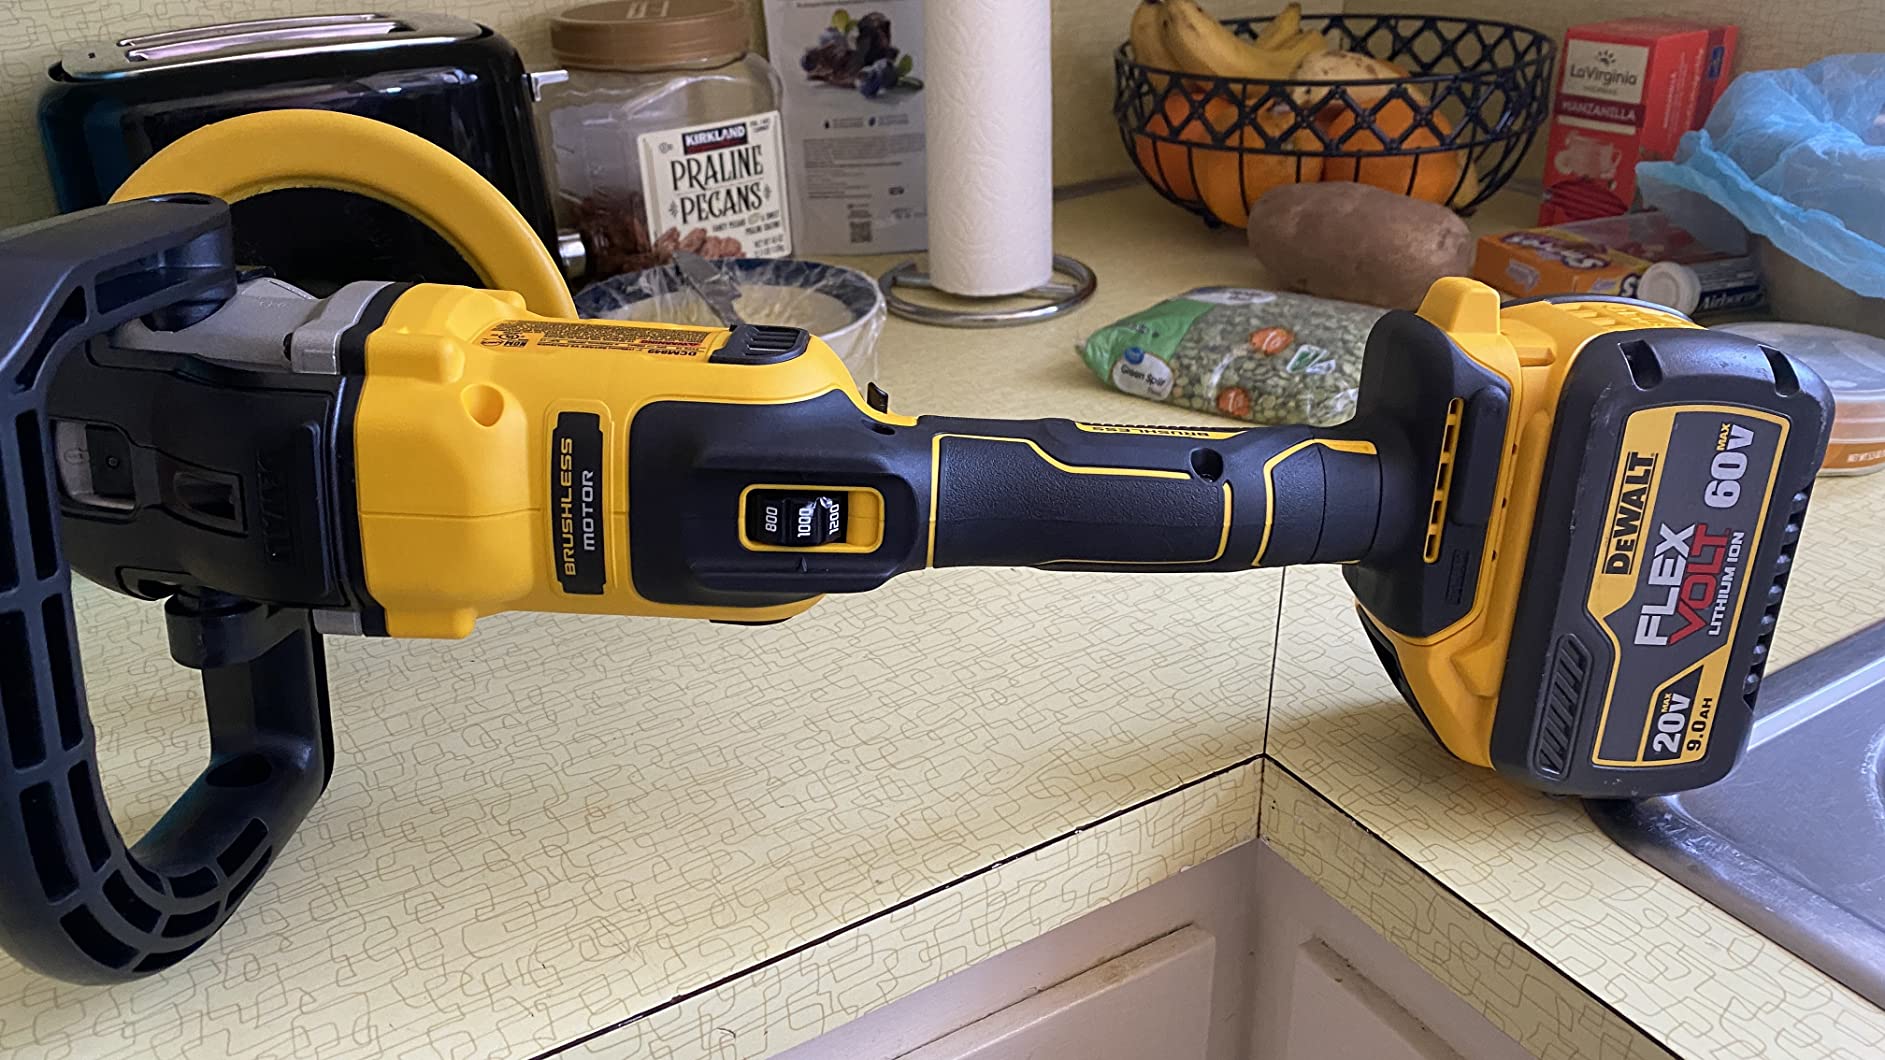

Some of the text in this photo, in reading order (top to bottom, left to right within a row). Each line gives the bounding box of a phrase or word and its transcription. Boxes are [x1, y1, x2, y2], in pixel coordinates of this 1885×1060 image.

[1561, 101, 1636, 122] MANZANILLA
[685, 125, 746, 147] KIRKLAND
[670, 144, 764, 192] PRALINE
[679, 182, 763, 225] PECANS
[1091, 426, 1210, 437] BRUSHLESS
[1715, 423, 1731, 451] MAX
[1704, 424, 1755, 509] 60V
[559, 437, 577, 576] BRUSHLESS
[581, 470, 595, 551] MOTOR
[765, 506, 778, 532] 800
[797, 507, 812, 538] 1000
[829, 503, 840, 535] 1200
[1634, 522, 1696, 646] FLEX
[1667, 523, 1731, 646] VOLT
[1708, 532, 1745, 636] LITHIUM ION
[1653, 693, 1691, 753] 20V
[1660, 692, 1672, 713] MAX
